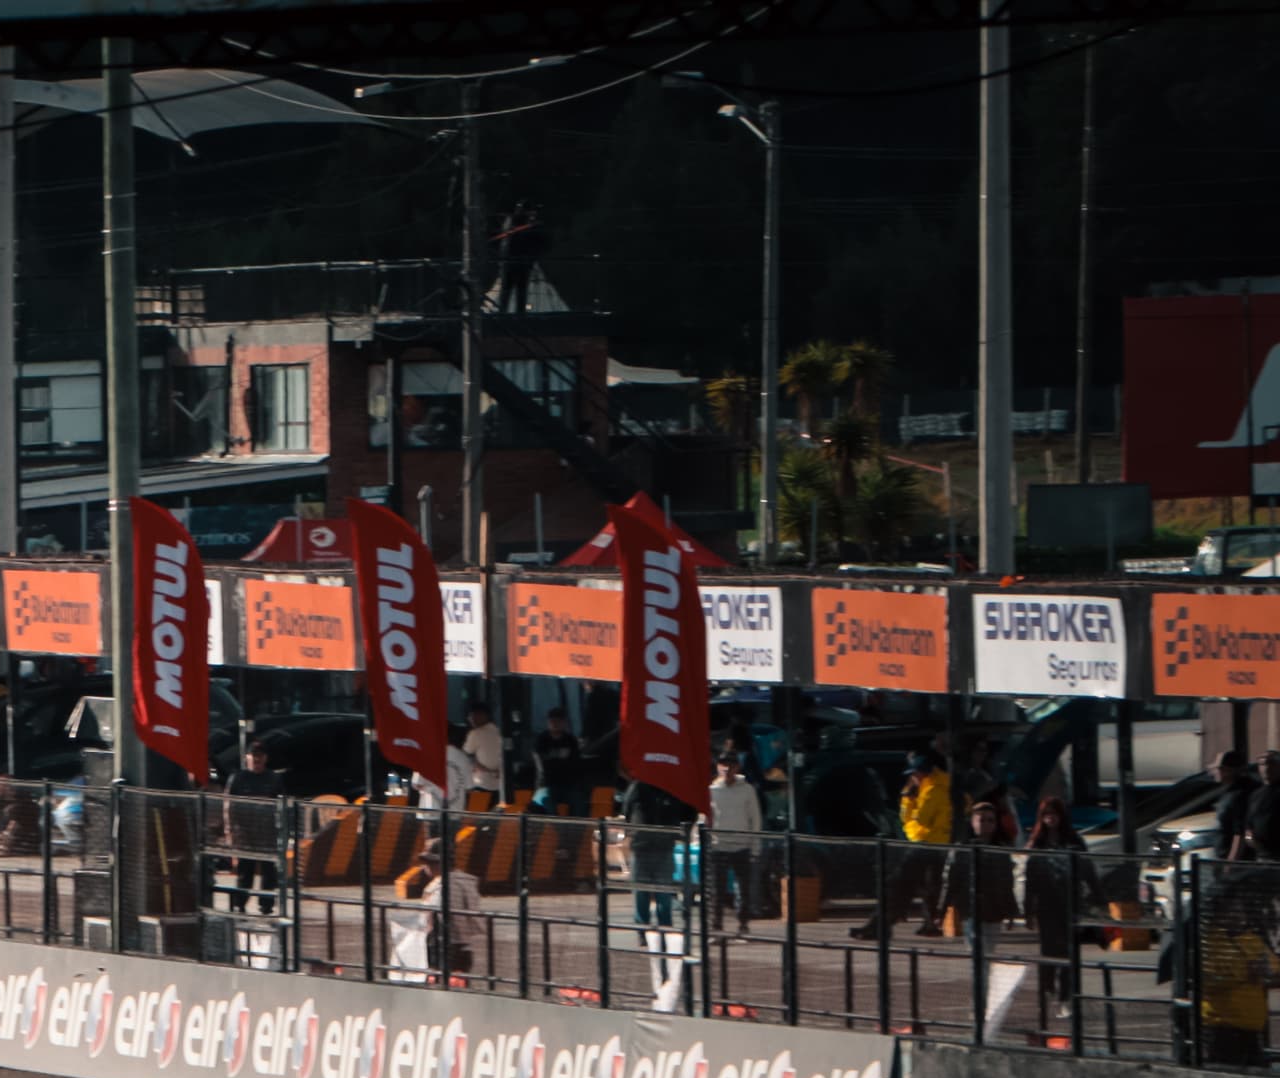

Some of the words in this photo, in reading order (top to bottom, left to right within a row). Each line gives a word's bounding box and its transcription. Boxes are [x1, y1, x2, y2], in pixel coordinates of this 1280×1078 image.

[152, 539, 189, 709] MOTUL
[377, 542, 421, 721] MOTUL
[644, 546, 681, 733] MOTUL
[719, 640, 774, 673] Seguros
[984, 600, 1116, 644] SUBROKER
[1048, 652, 1119, 689] Seguros
[47, 980, 92, 1048] elf
[114, 991, 160, 1058] elf
[183, 999, 228, 1068] elf
[252, 1006, 297, 1076] elf
